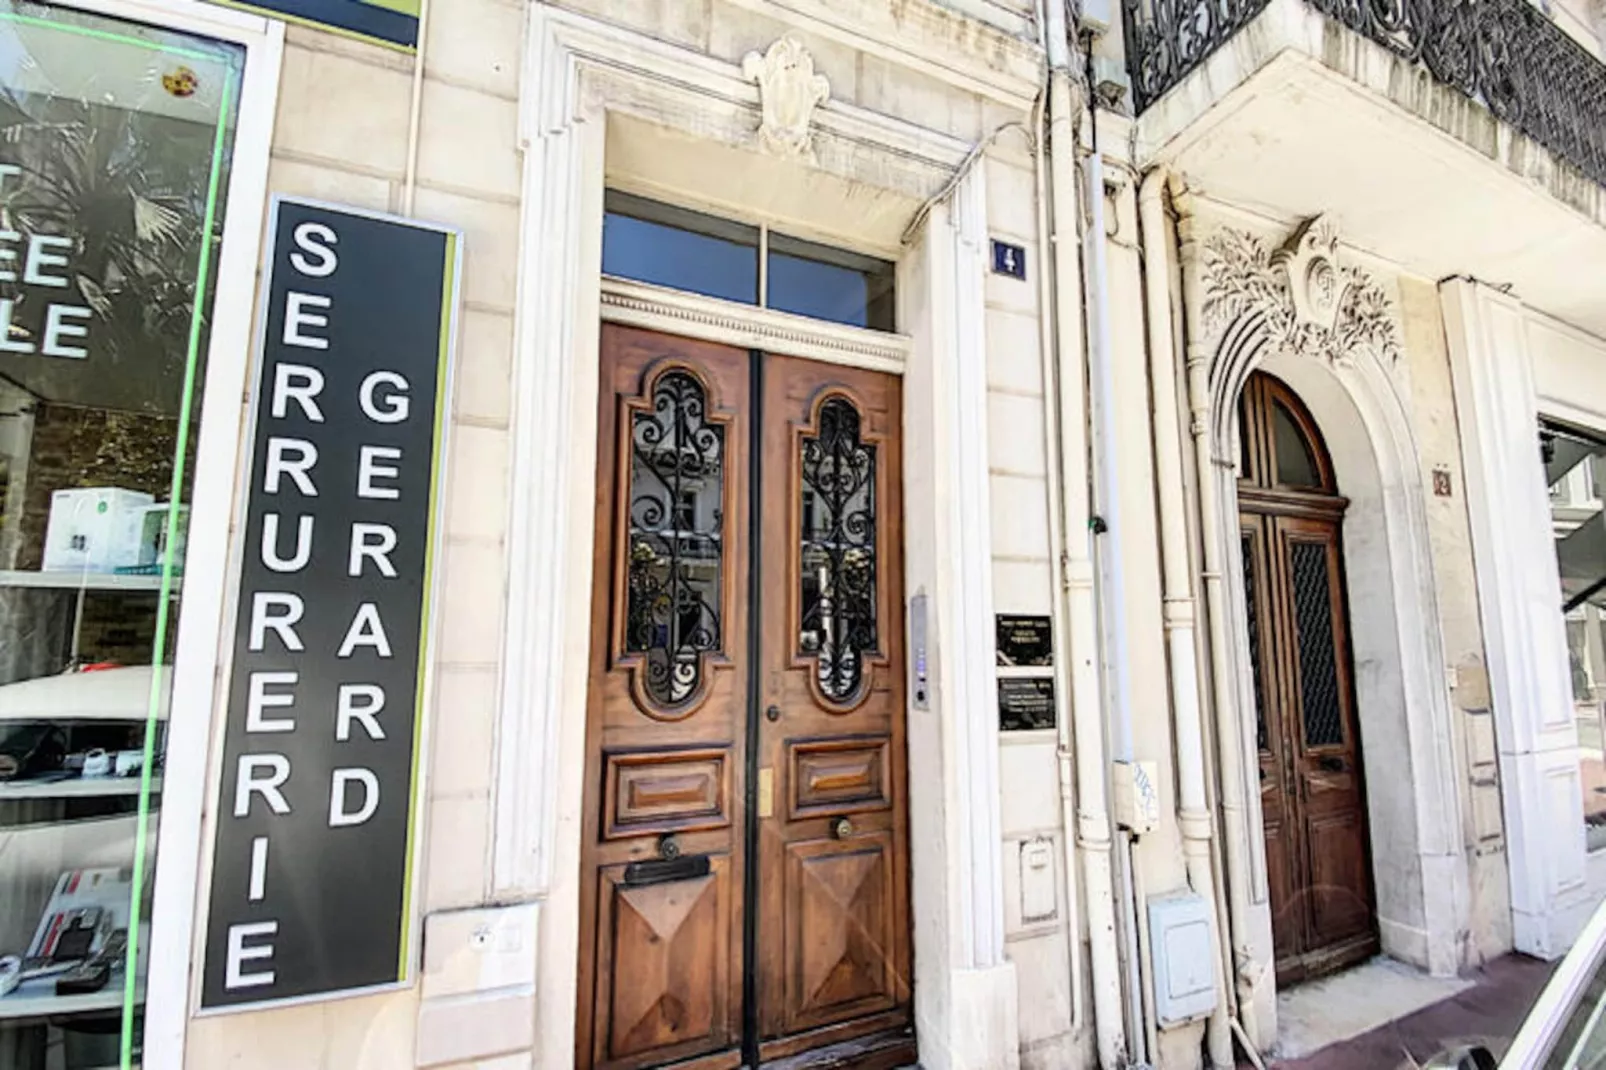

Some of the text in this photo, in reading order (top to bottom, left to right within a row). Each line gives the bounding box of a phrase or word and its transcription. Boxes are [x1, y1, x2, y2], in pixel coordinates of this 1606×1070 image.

[1004, 248, 1016, 272] 4
[224, 222, 339, 989] SERRURERIE
[329, 371, 411, 827] GERARD
